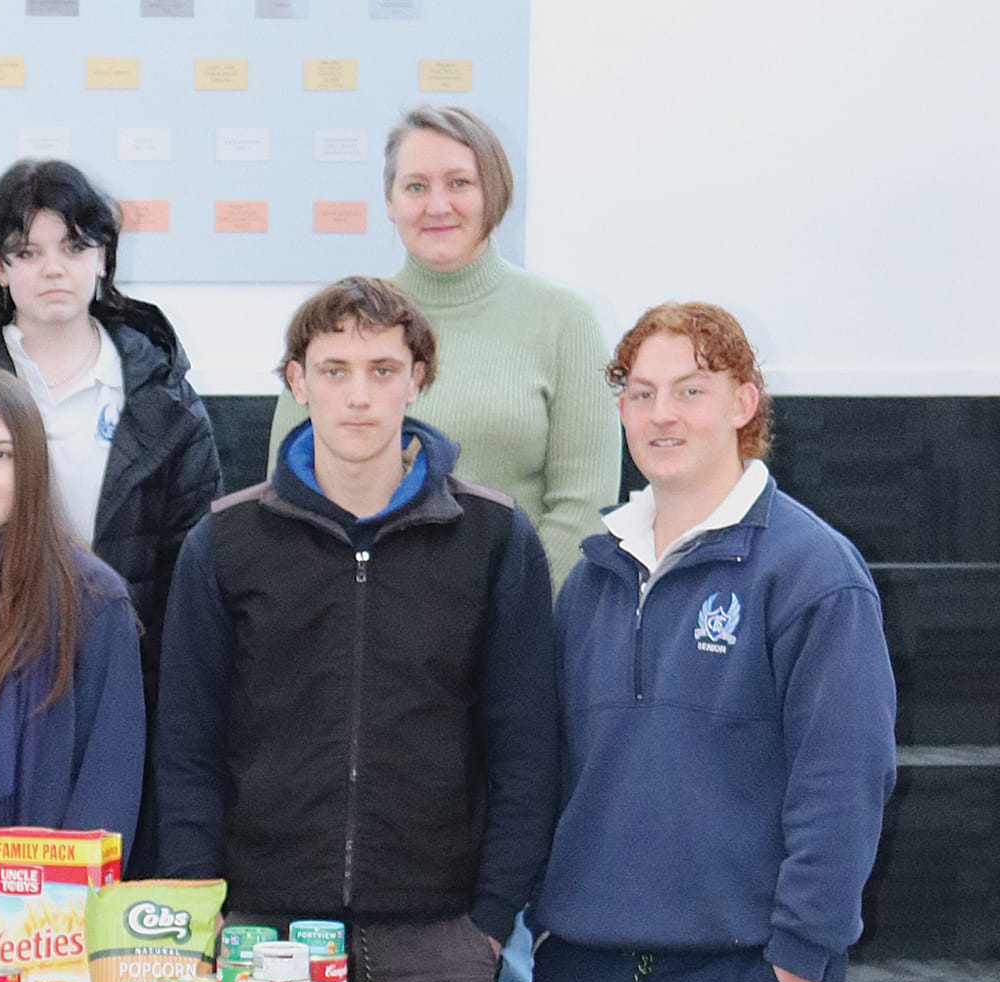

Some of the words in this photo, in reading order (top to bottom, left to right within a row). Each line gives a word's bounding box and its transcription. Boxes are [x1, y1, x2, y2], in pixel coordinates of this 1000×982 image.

[42, 845, 76, 861] PACK
[0, 869, 39, 881] UNCLE
[1, 880, 40, 893] TOBYS
[128, 902, 189, 940] Cobs
[135, 947, 181, 956] NATURAL
[119, 961, 198, 978] POPCORN
